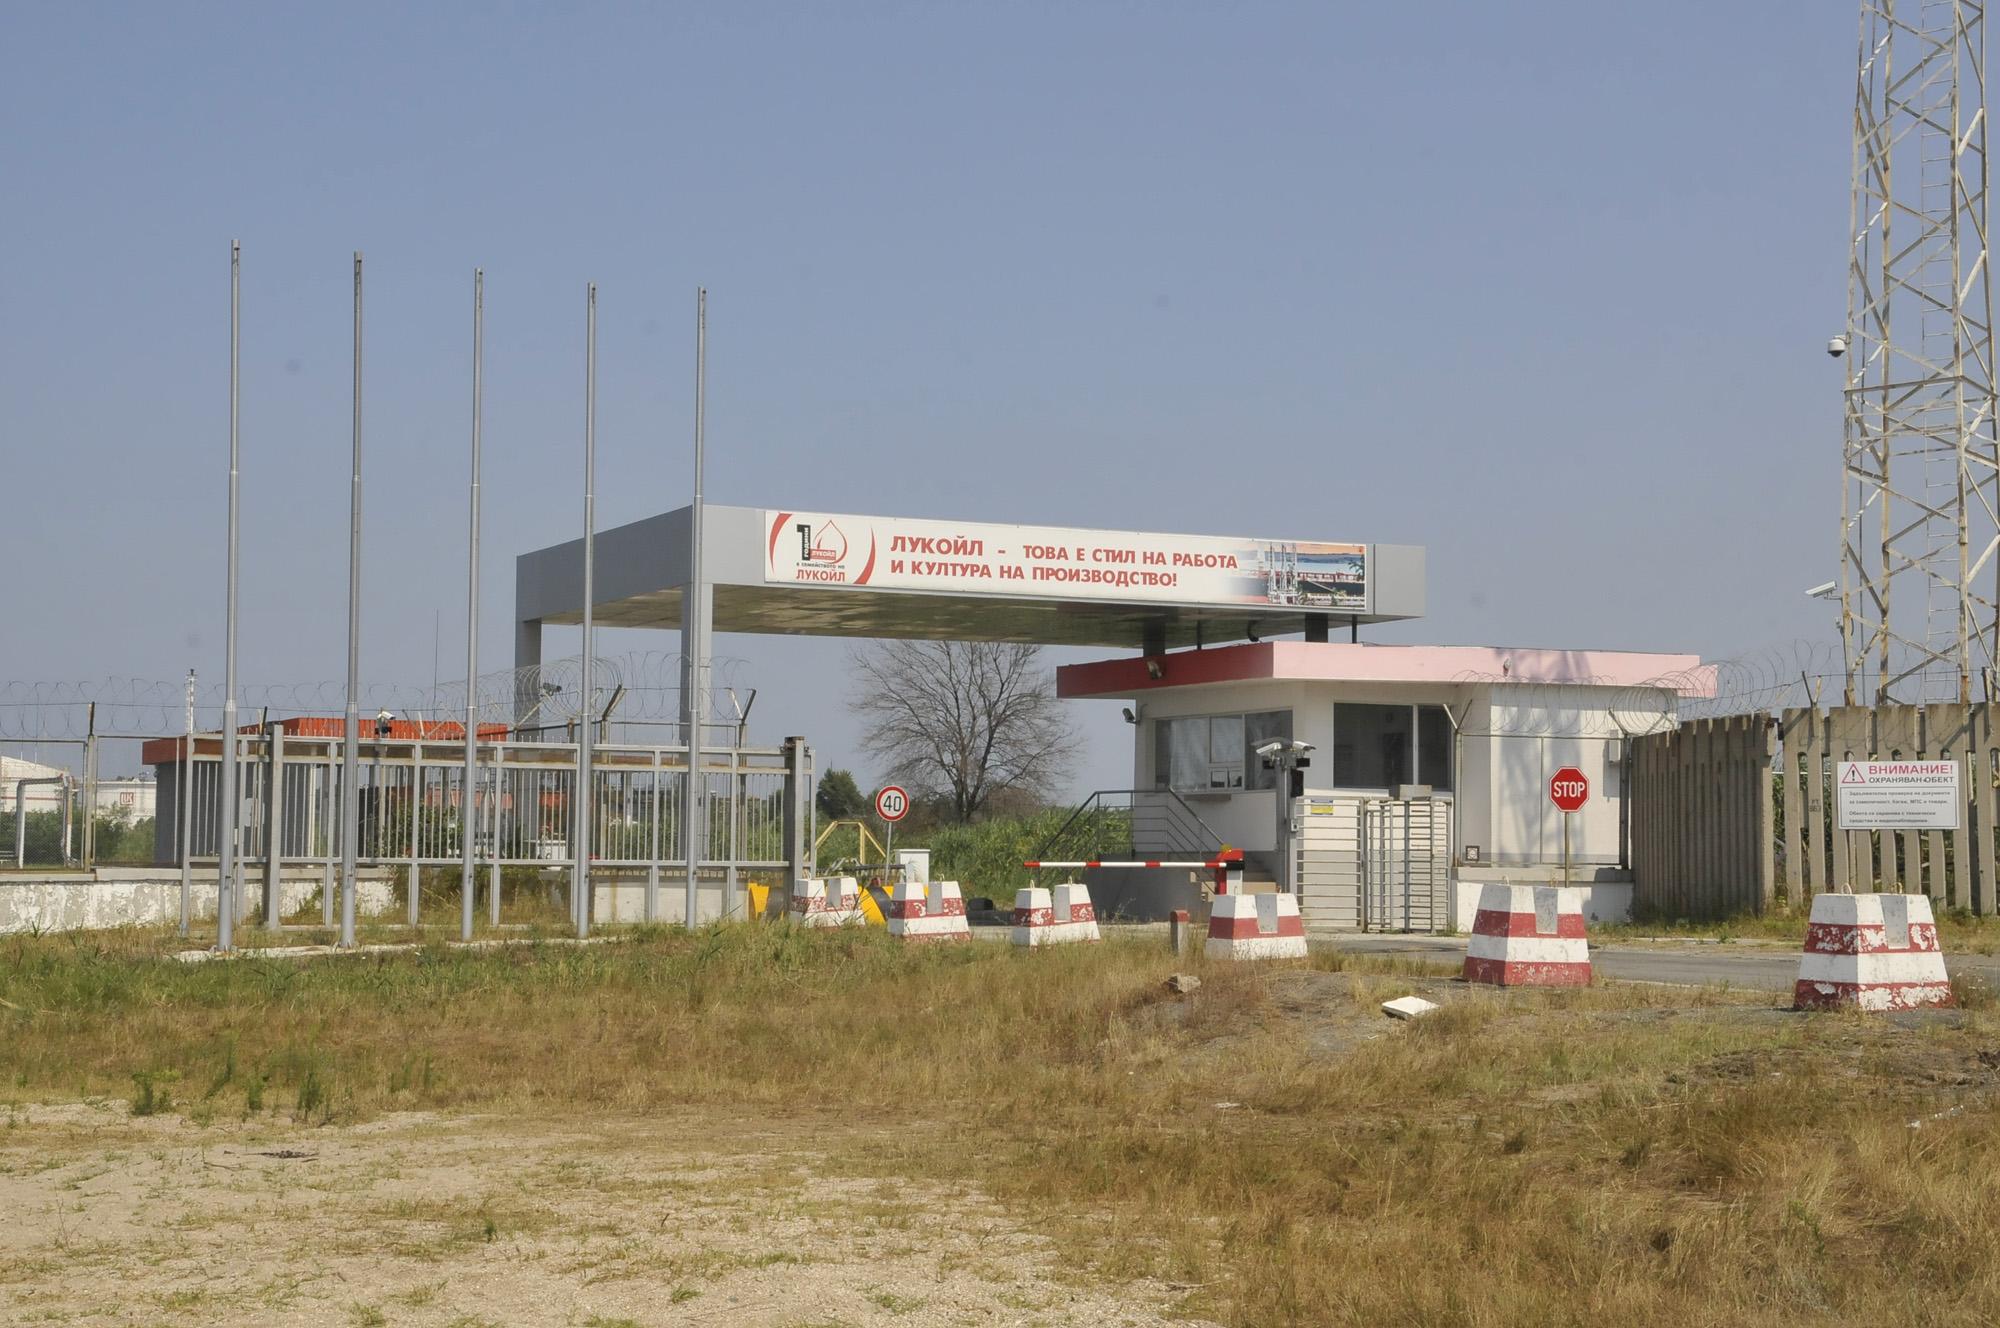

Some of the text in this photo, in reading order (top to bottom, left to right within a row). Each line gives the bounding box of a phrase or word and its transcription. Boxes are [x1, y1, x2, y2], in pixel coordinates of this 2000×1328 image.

[890, 535, 983, 557] ЛУКОЙЛ
[1022, 545, 1069, 561] ТОВА
[1076, 547, 1086, 562] Е
[1091, 548, 1136, 564] СТИЛ
[1142, 551, 1167, 566] НА
[1172, 552, 1238, 569] РАБОТА
[796, 568, 845, 582] ЛУКОЙЛ
[890, 560, 1177, 587] И КУЛТУРА НА ПРОИЗВОДСТВО!
[1868, 764, 1953, 775] ВНИМАНИЕ!
[1869, 776, 1954, 784] ОХРАНЯВАН ОБЕКТ
[1553, 781, 1585, 797] STOP
[883, 795, 902, 812] 40
